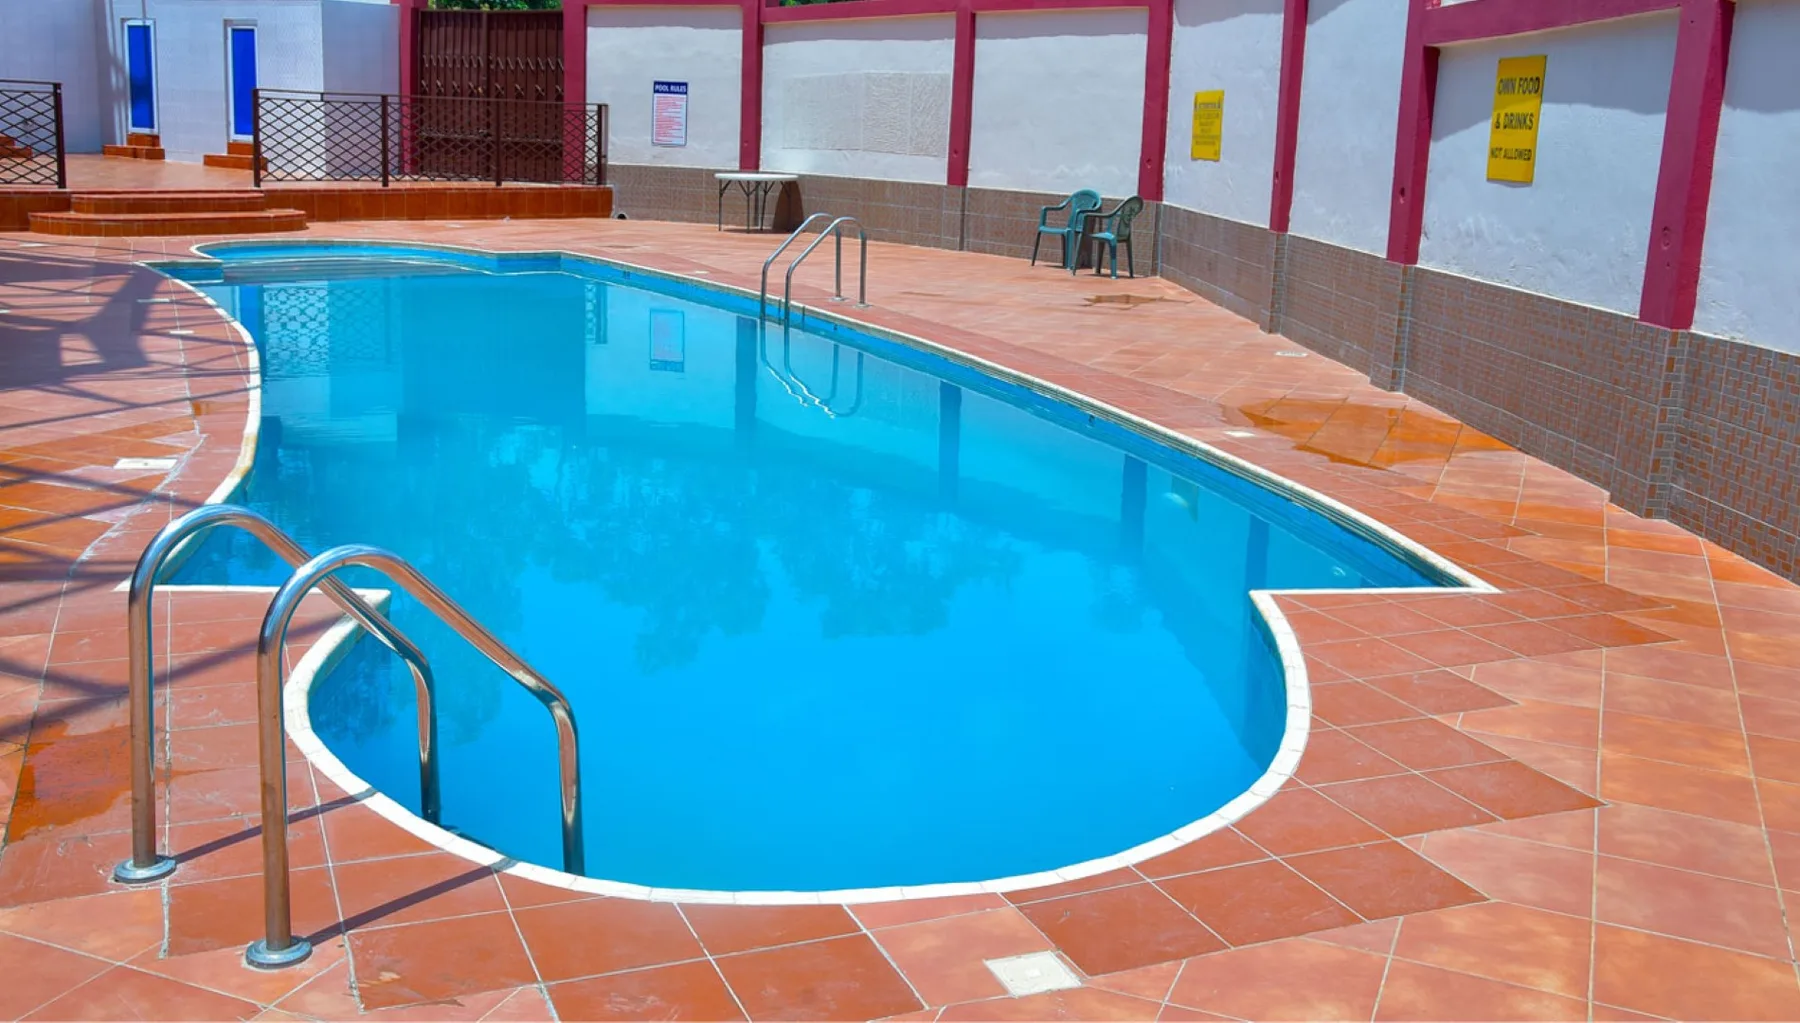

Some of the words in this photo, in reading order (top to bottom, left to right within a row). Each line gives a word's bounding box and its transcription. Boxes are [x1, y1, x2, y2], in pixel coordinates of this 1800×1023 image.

[655, 84, 669, 92] POOL
[670, 85, 687, 93] RULES
[1497, 78, 1516, 95] OWN
[1518, 77, 1540, 95] FOOD
[1495, 112, 1501, 129] &
[1503, 112, 1534, 130] DRINKS
[1491, 148, 1502, 158] NOT
[1503, 148, 1532, 161] ALLOWED
